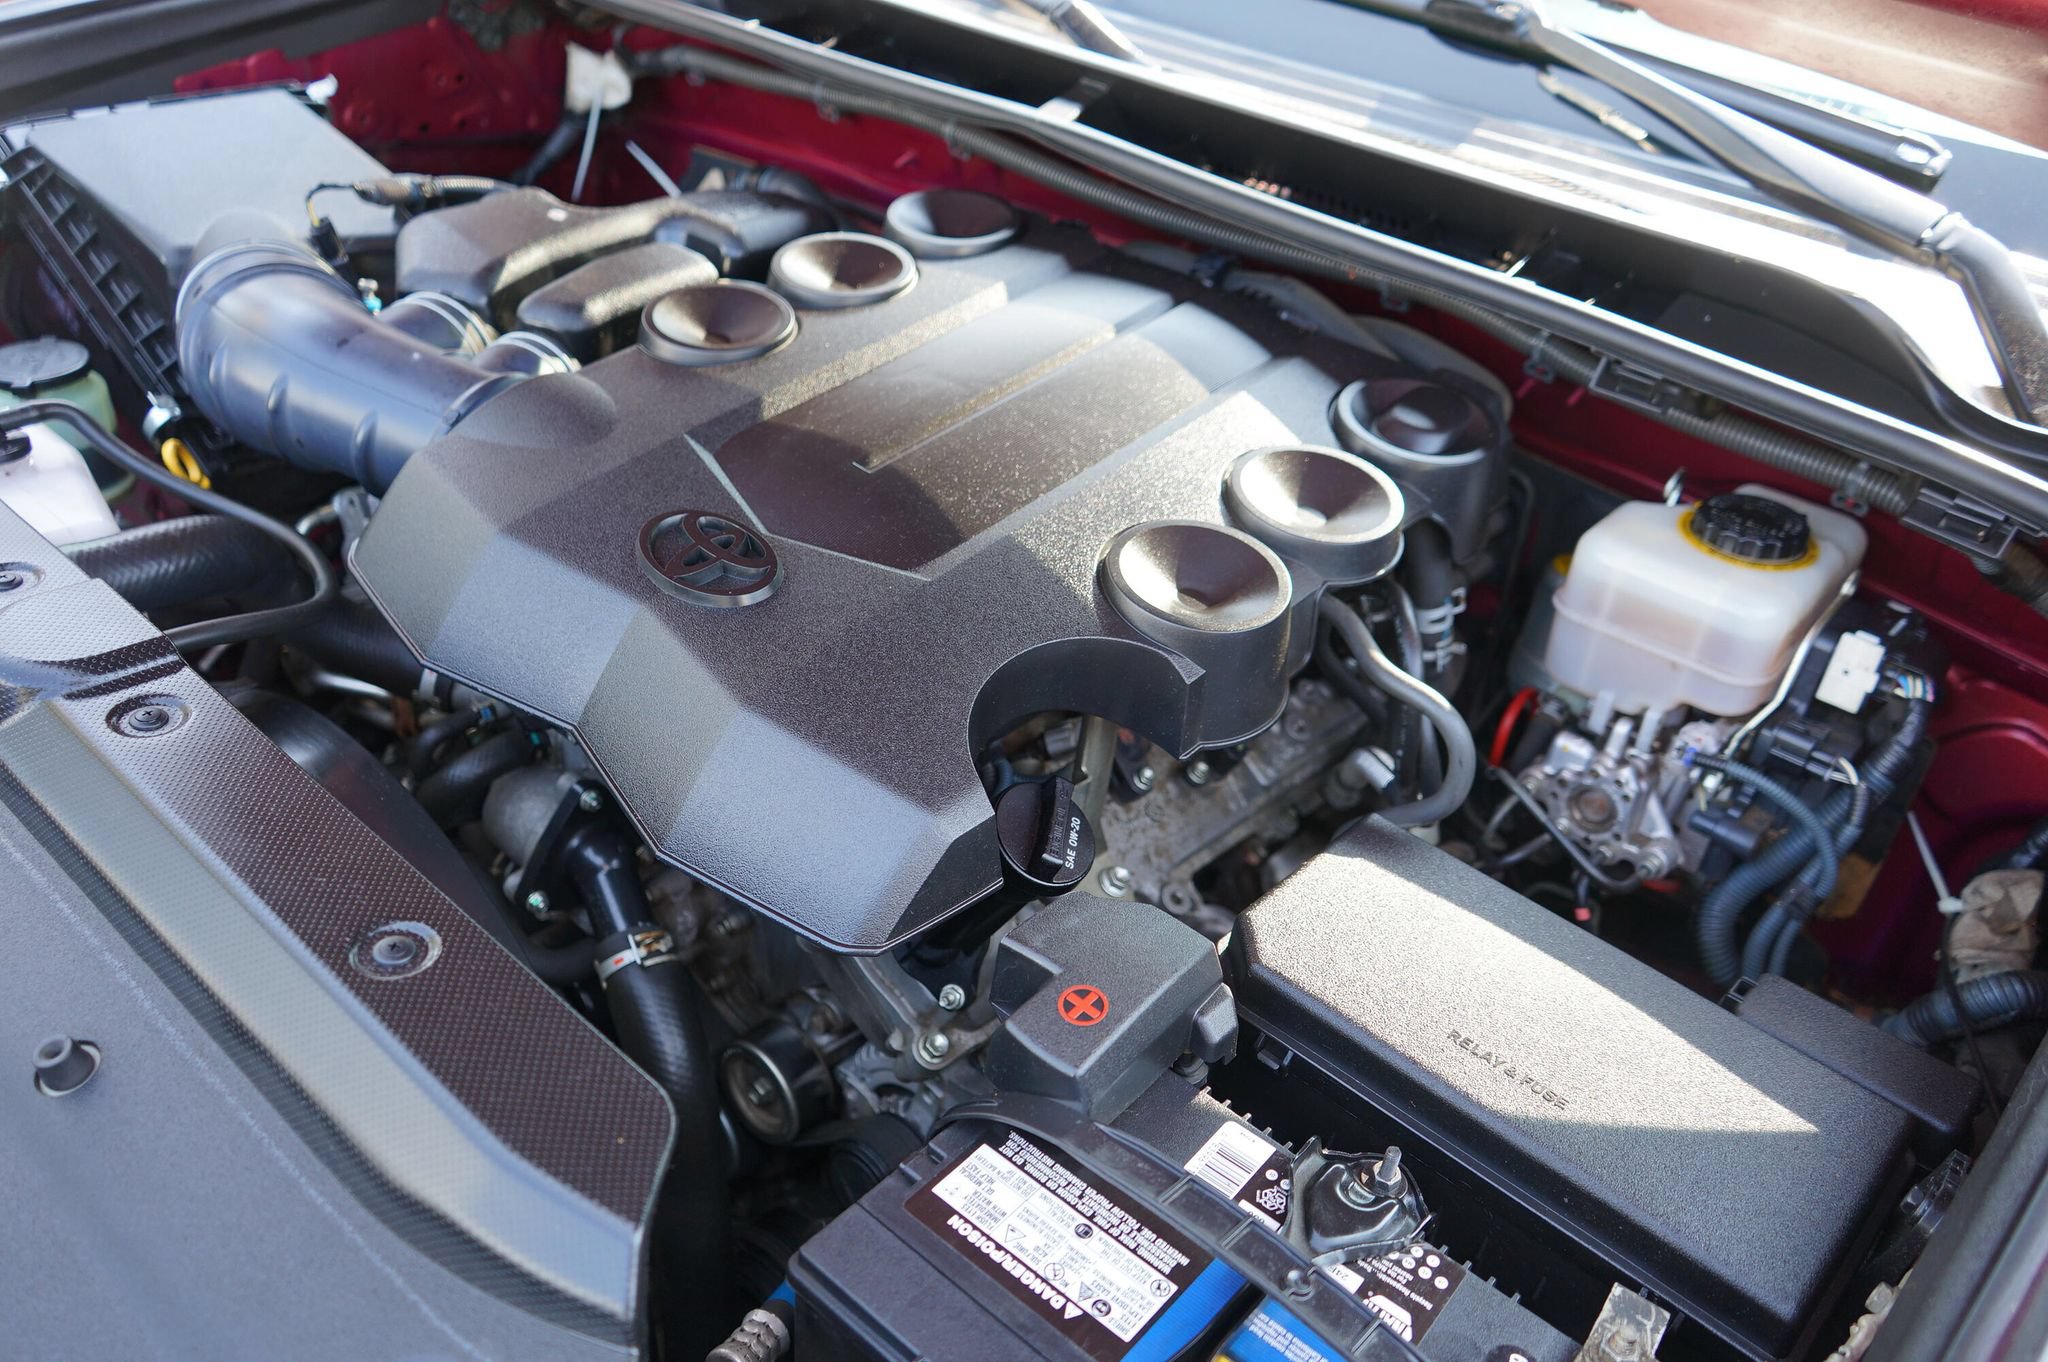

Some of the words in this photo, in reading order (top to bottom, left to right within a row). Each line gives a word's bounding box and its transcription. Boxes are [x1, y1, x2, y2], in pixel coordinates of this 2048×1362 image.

[1066, 816, 1083, 847] 0W-20
[1063, 847, 1077, 869] SAE
[1446, 1026, 1507, 1072] RELAY
[1502, 1063, 1519, 1079] &
[1519, 1072, 1570, 1112] FUSE
[996, 1144, 1015, 1158] NOT
[1003, 1139, 1021, 1153] FOR
[1010, 1154, 1025, 1166] DO
[1016, 1148, 1068, 1187] RECOMMENDED
[957, 1166, 984, 1187] MEDICAL
[979, 1172, 996, 1185] HELP
[1043, 1178, 1059, 1191] OR
[1050, 1162, 1088, 1191] CHARGING
[981, 1184, 995, 1195] GET
[1063, 1182, 1082, 1198] NOT
[1082, 1186, 1114, 1210] PROPER
[960, 1202, 977, 1216] EYES
[961, 1192, 1001, 1224] IMMEDIATELY
[990, 1203, 1008, 1218] WITH
[1053, 1186, 1094, 1217] EXPLOSION
[974, 1213, 995, 1230] FLUSH
[1109, 1205, 1141, 1230] FOLLOW
[1106, 1225, 1122, 1238] OF
[1116, 1221, 1132, 1234] OR
[1116, 1232, 1138, 1250] RISK
[1127, 1229, 1178, 1268] DISASSEMBLE
[1153, 1237, 1190, 1266] INVERTED
[944, 1212, 1068, 1311] DANGER/POISON
